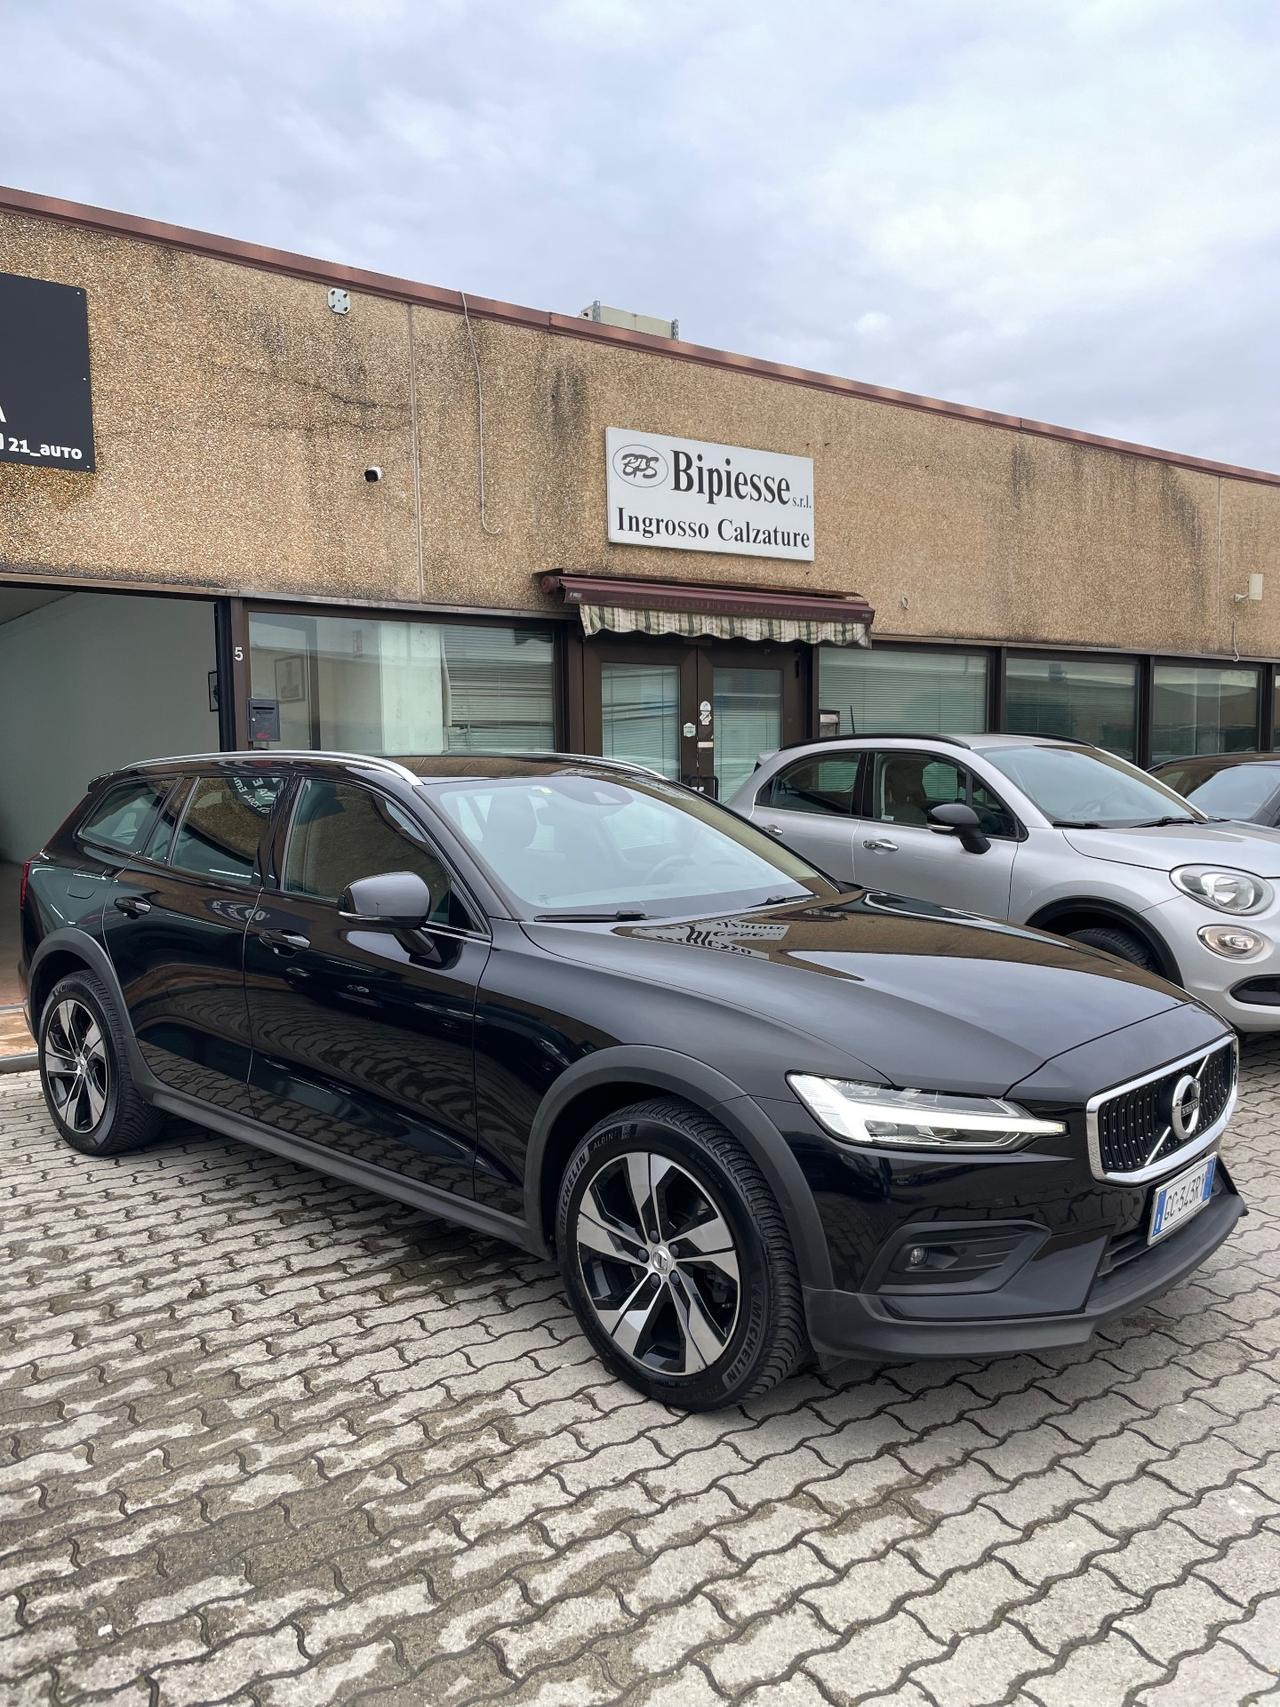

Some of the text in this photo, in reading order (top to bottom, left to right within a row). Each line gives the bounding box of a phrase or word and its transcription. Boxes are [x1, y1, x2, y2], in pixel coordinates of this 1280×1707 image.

[669, 449, 791, 505] Bipiesse
[617, 506, 810, 549] Ingrosso Calzature
[234, 646, 244, 661] 5
[560, 1151, 587, 1230] MICHELIN
[726, 1300, 762, 1384] MICHELIN
